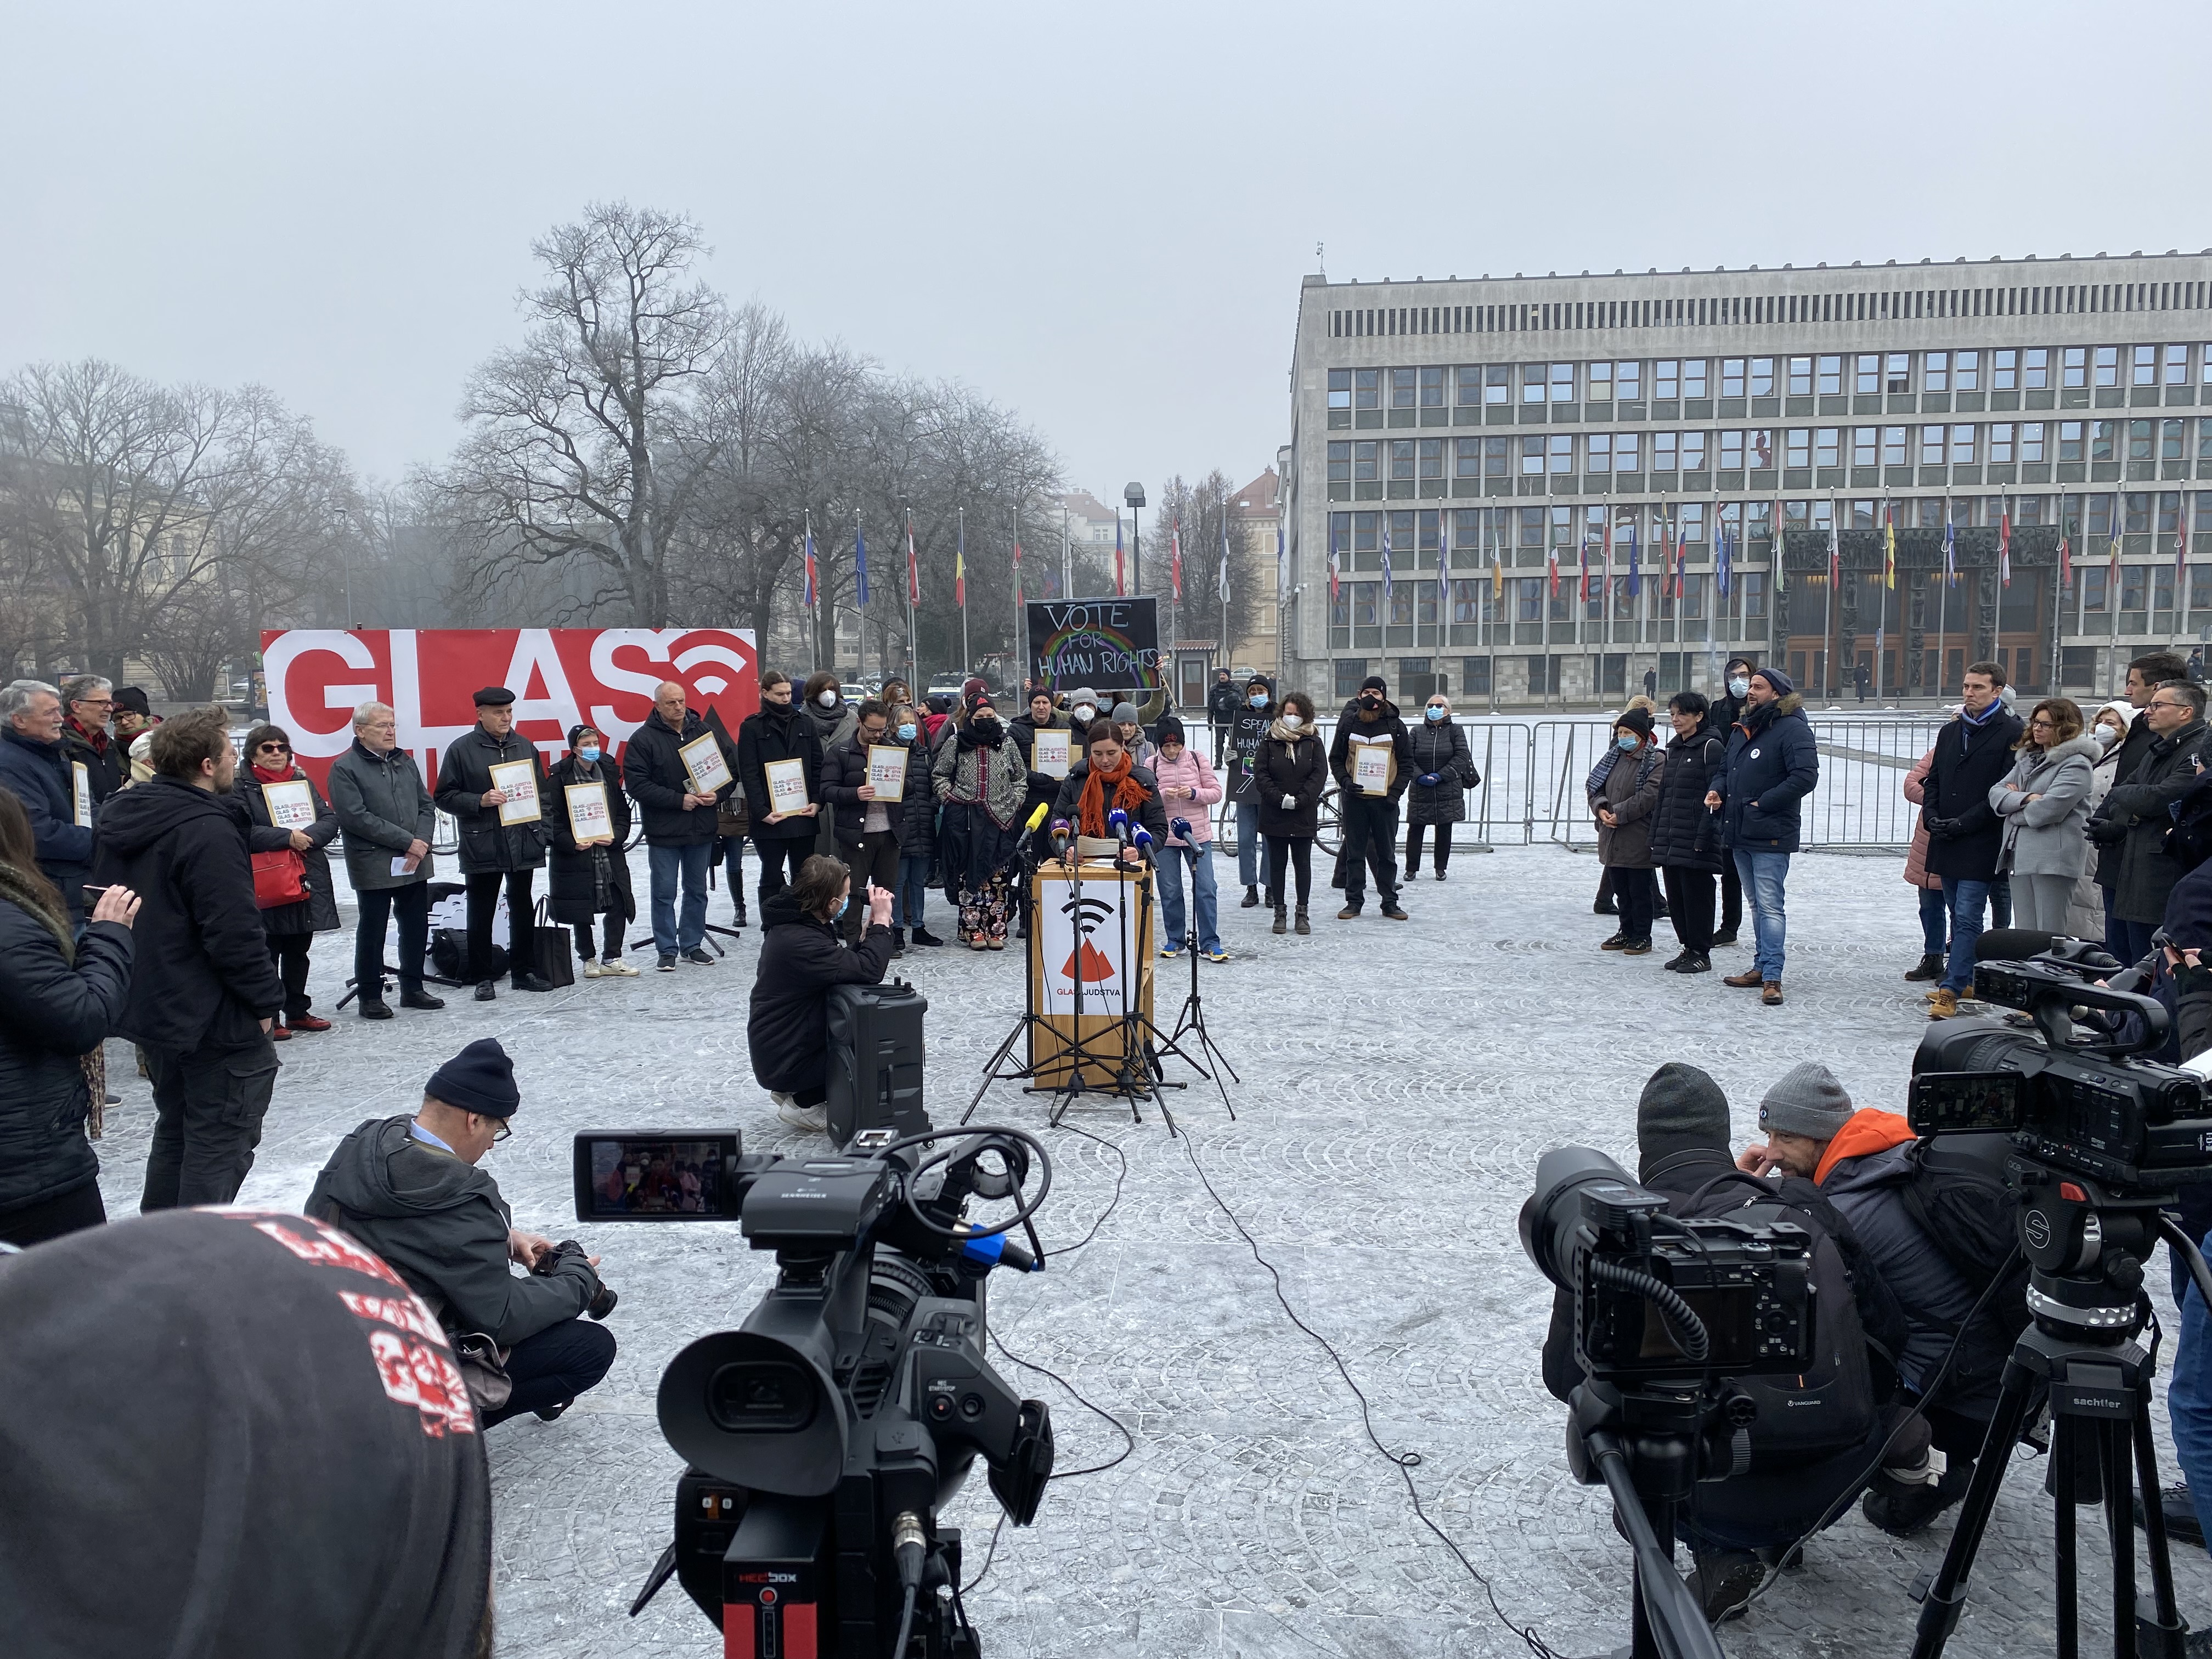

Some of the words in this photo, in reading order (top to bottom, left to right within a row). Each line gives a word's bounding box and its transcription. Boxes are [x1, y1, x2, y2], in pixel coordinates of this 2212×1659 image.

[1043, 603, 1131, 631] VOTE
[1068, 631, 1102, 648] FOR
[1038, 653, 1093, 677] HUMAN
[1099, 648, 1160, 673] RIGHTS
[262, 629, 670, 758] GLAS
[1240, 719, 1273, 731] SPEAK
[1237, 737, 1262, 749] HUMA
[1057, 988, 1121, 996] GLAJUDSTVA
[2074, 1398, 2121, 1408] sachtler
